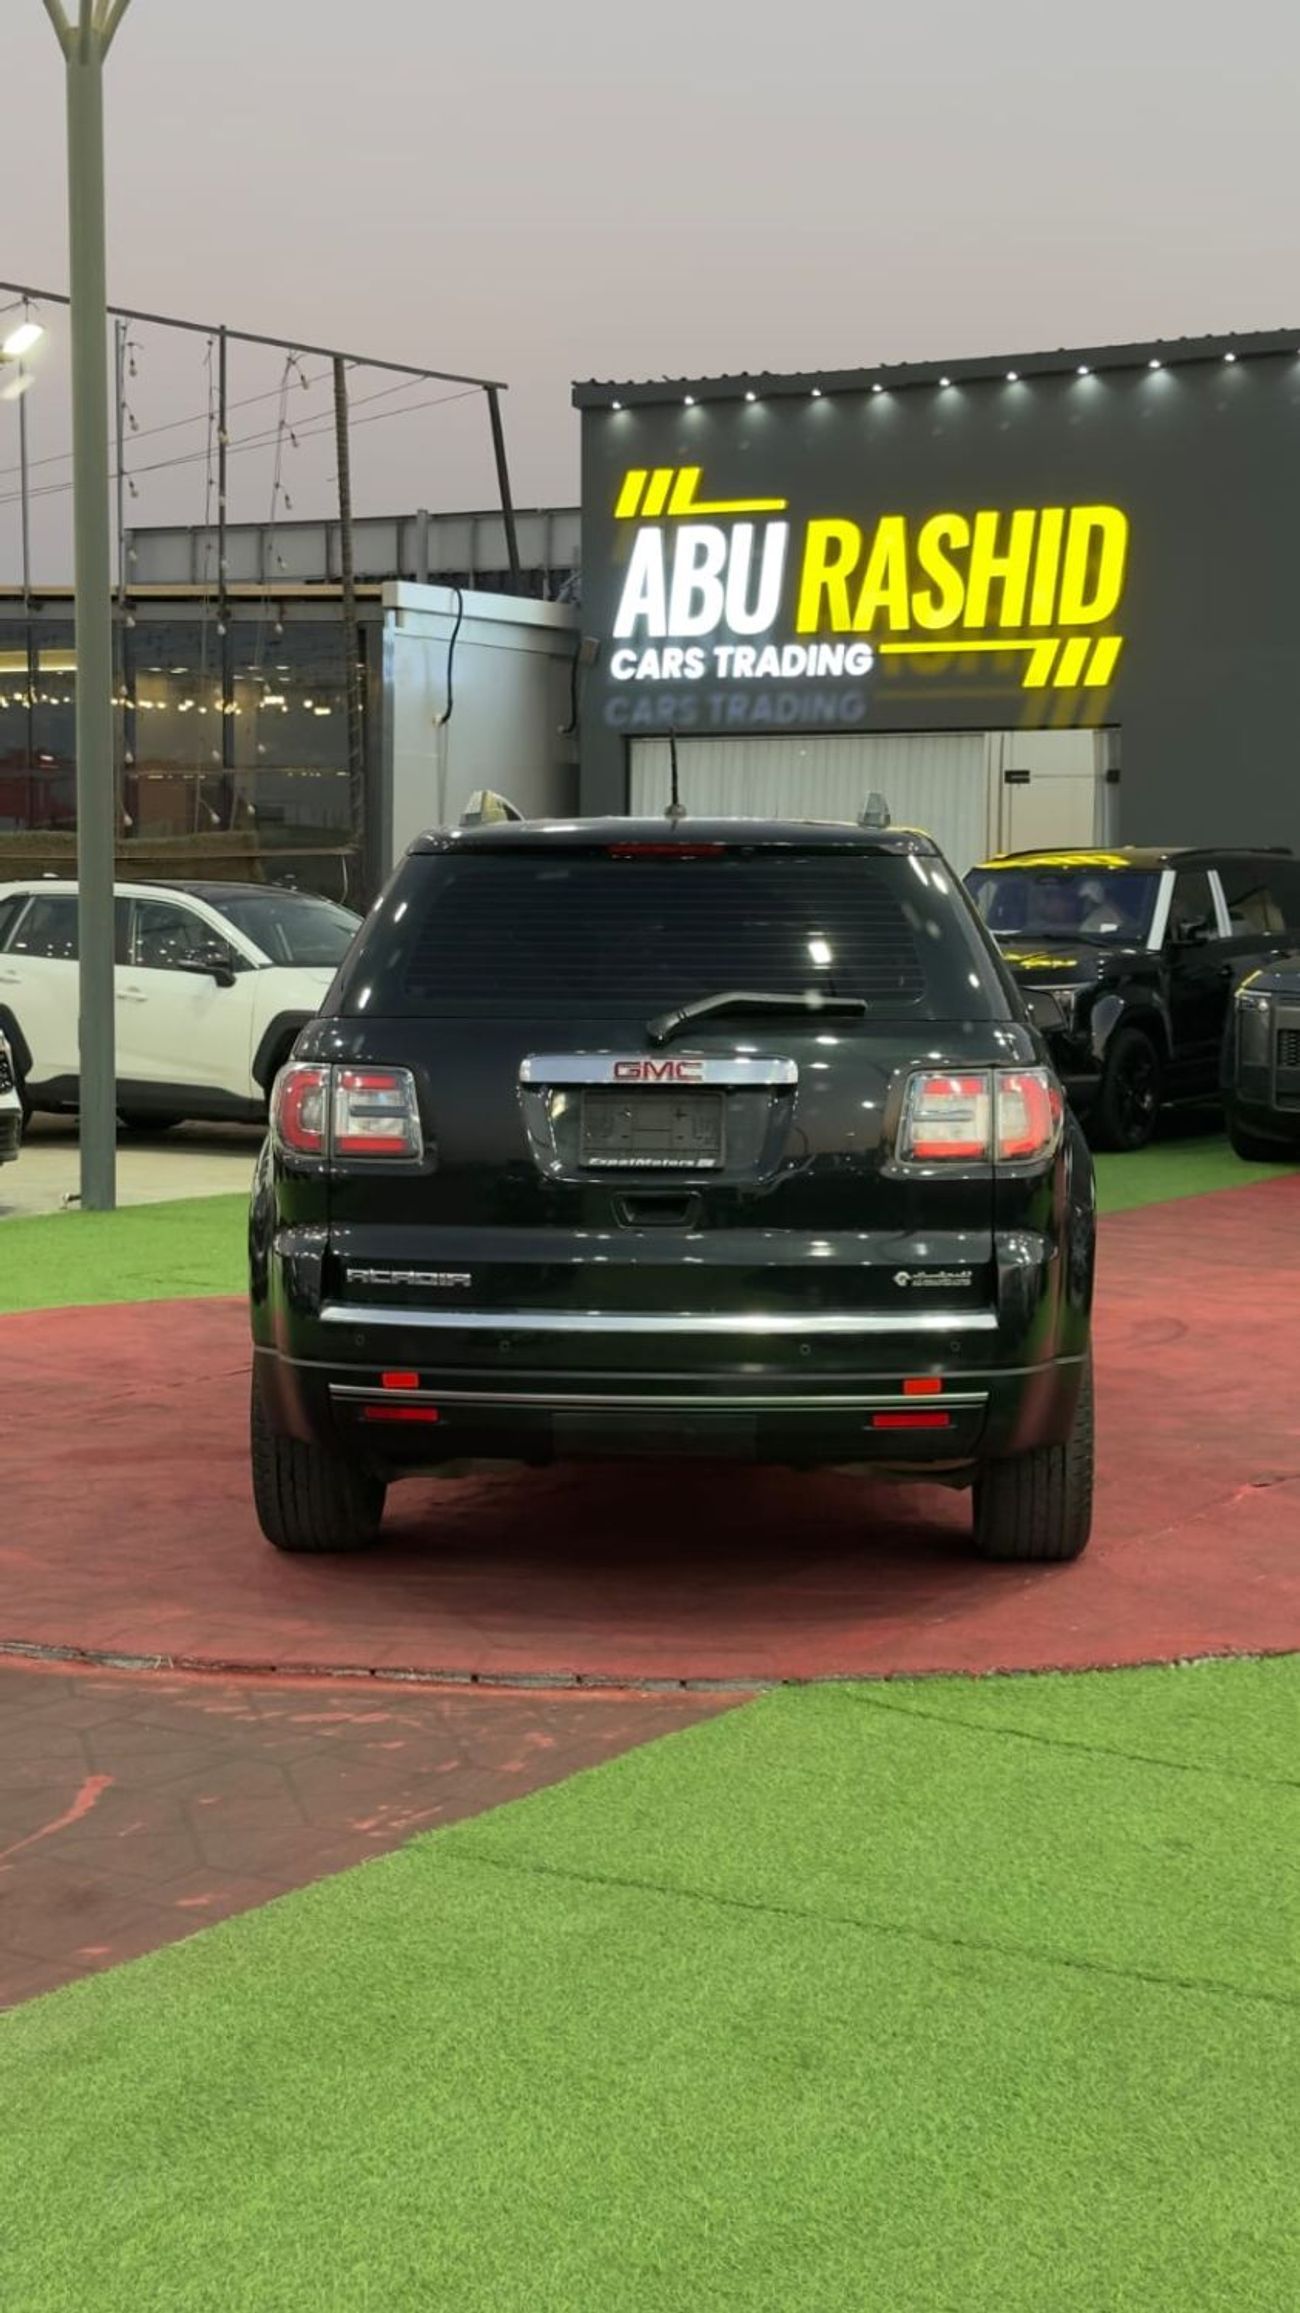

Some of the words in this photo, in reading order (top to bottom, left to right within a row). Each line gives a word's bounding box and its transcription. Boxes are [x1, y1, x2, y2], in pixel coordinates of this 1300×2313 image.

[612, 521, 789, 638] ABU
[796, 505, 1129, 634] RASHID
[610, 646, 706, 681] CARS
[713, 642, 875, 678] TRADING
[614, 1060, 703, 1082] GMC
[346, 1268, 472, 1287] ACADIA
